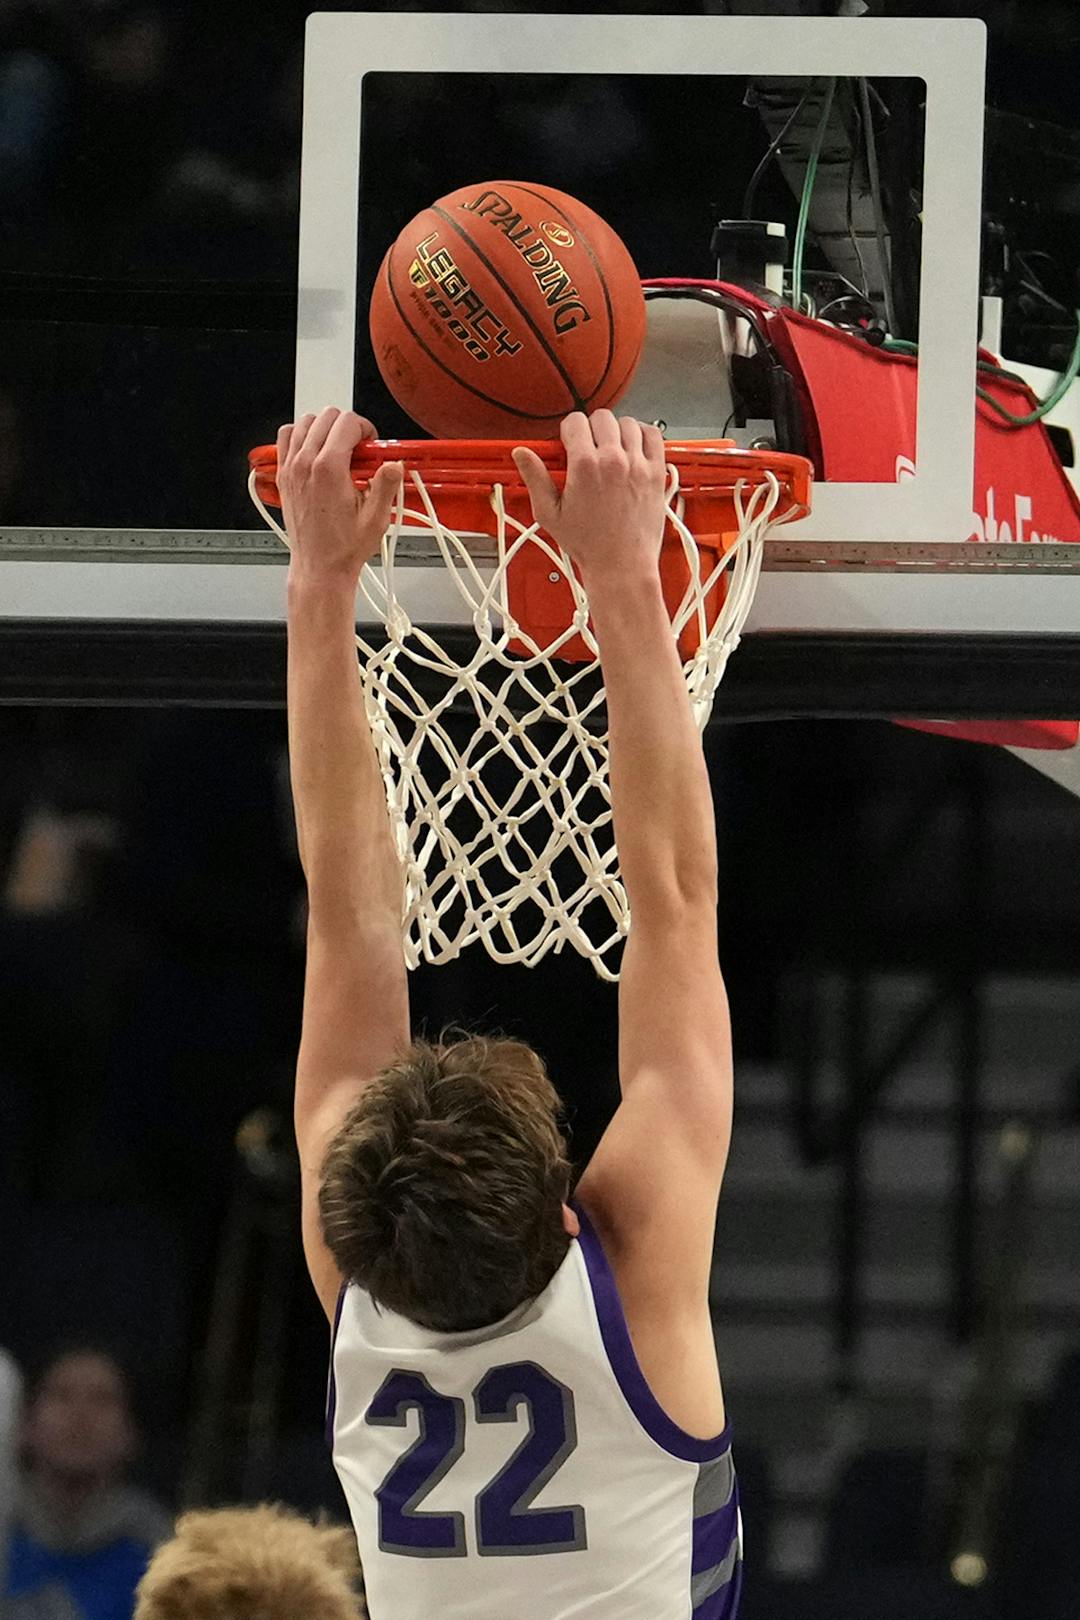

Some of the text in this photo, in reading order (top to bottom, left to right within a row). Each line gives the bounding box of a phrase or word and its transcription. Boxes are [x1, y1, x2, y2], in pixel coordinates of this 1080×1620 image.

[415, 231, 524, 357] LEGACY
[460, 190, 592, 336] SPALDING
[364, 1359, 588, 1558] 22
